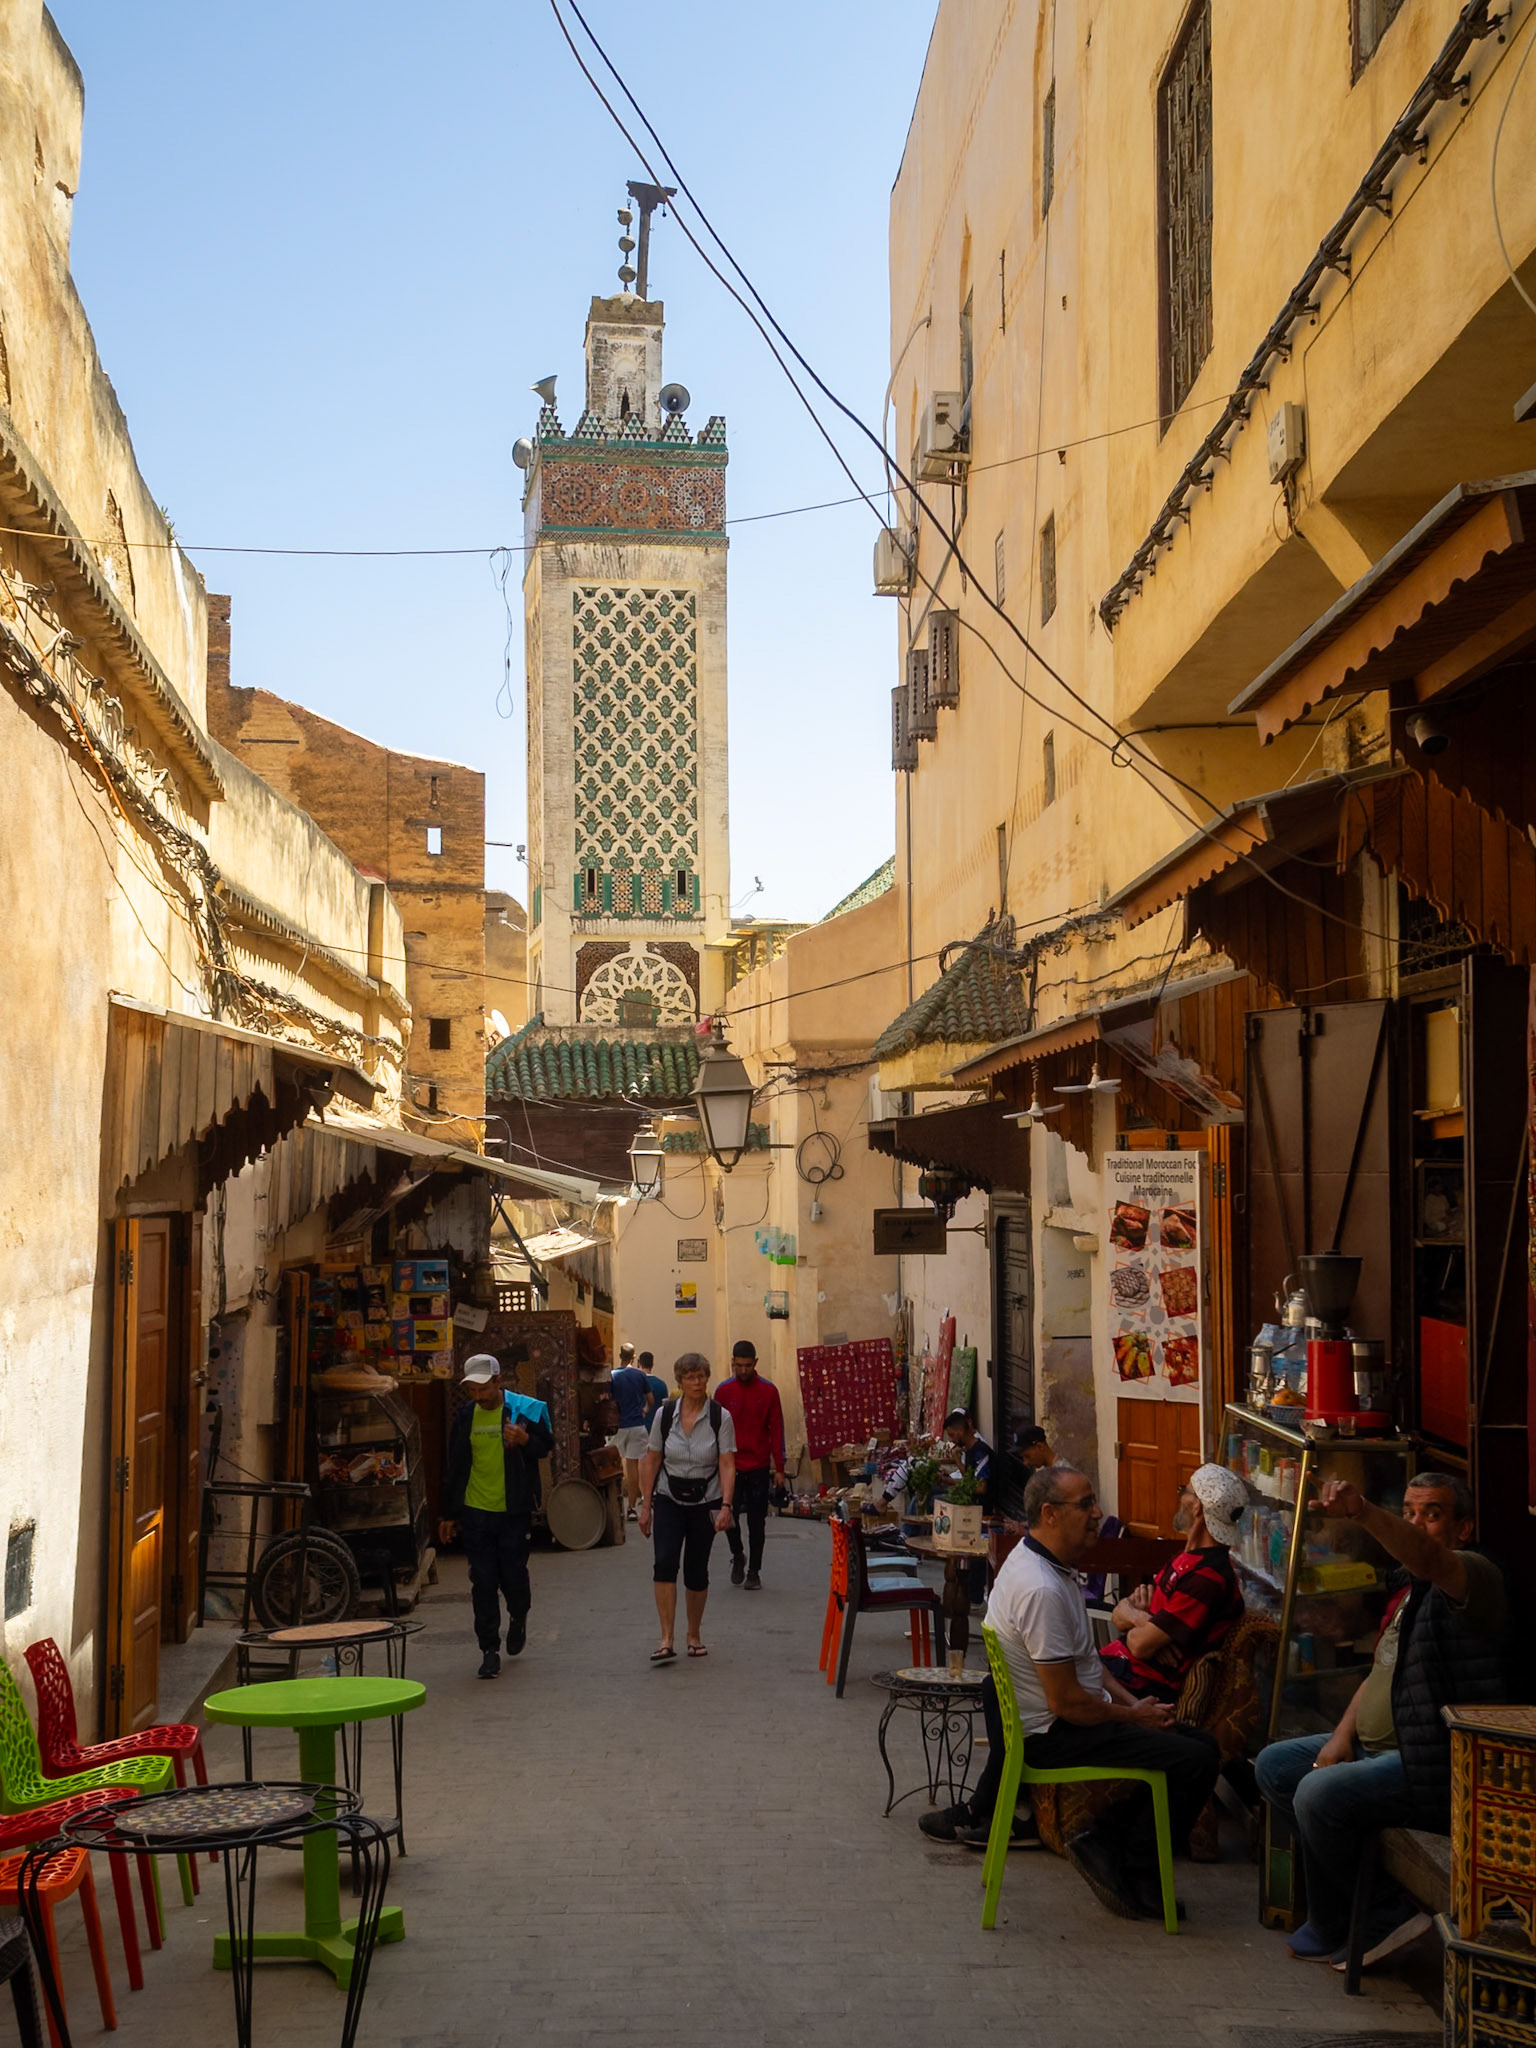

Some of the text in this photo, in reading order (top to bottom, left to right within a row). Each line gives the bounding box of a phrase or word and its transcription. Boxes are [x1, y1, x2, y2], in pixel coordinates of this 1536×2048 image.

[1106, 1157, 1144, 1170] Traditional
[1146, 1158, 1182, 1170] Moroccan
[1115, 1171, 1194, 1184] Cuisine traditionnelle
[1133, 1184, 1173, 1196] Marocaine
